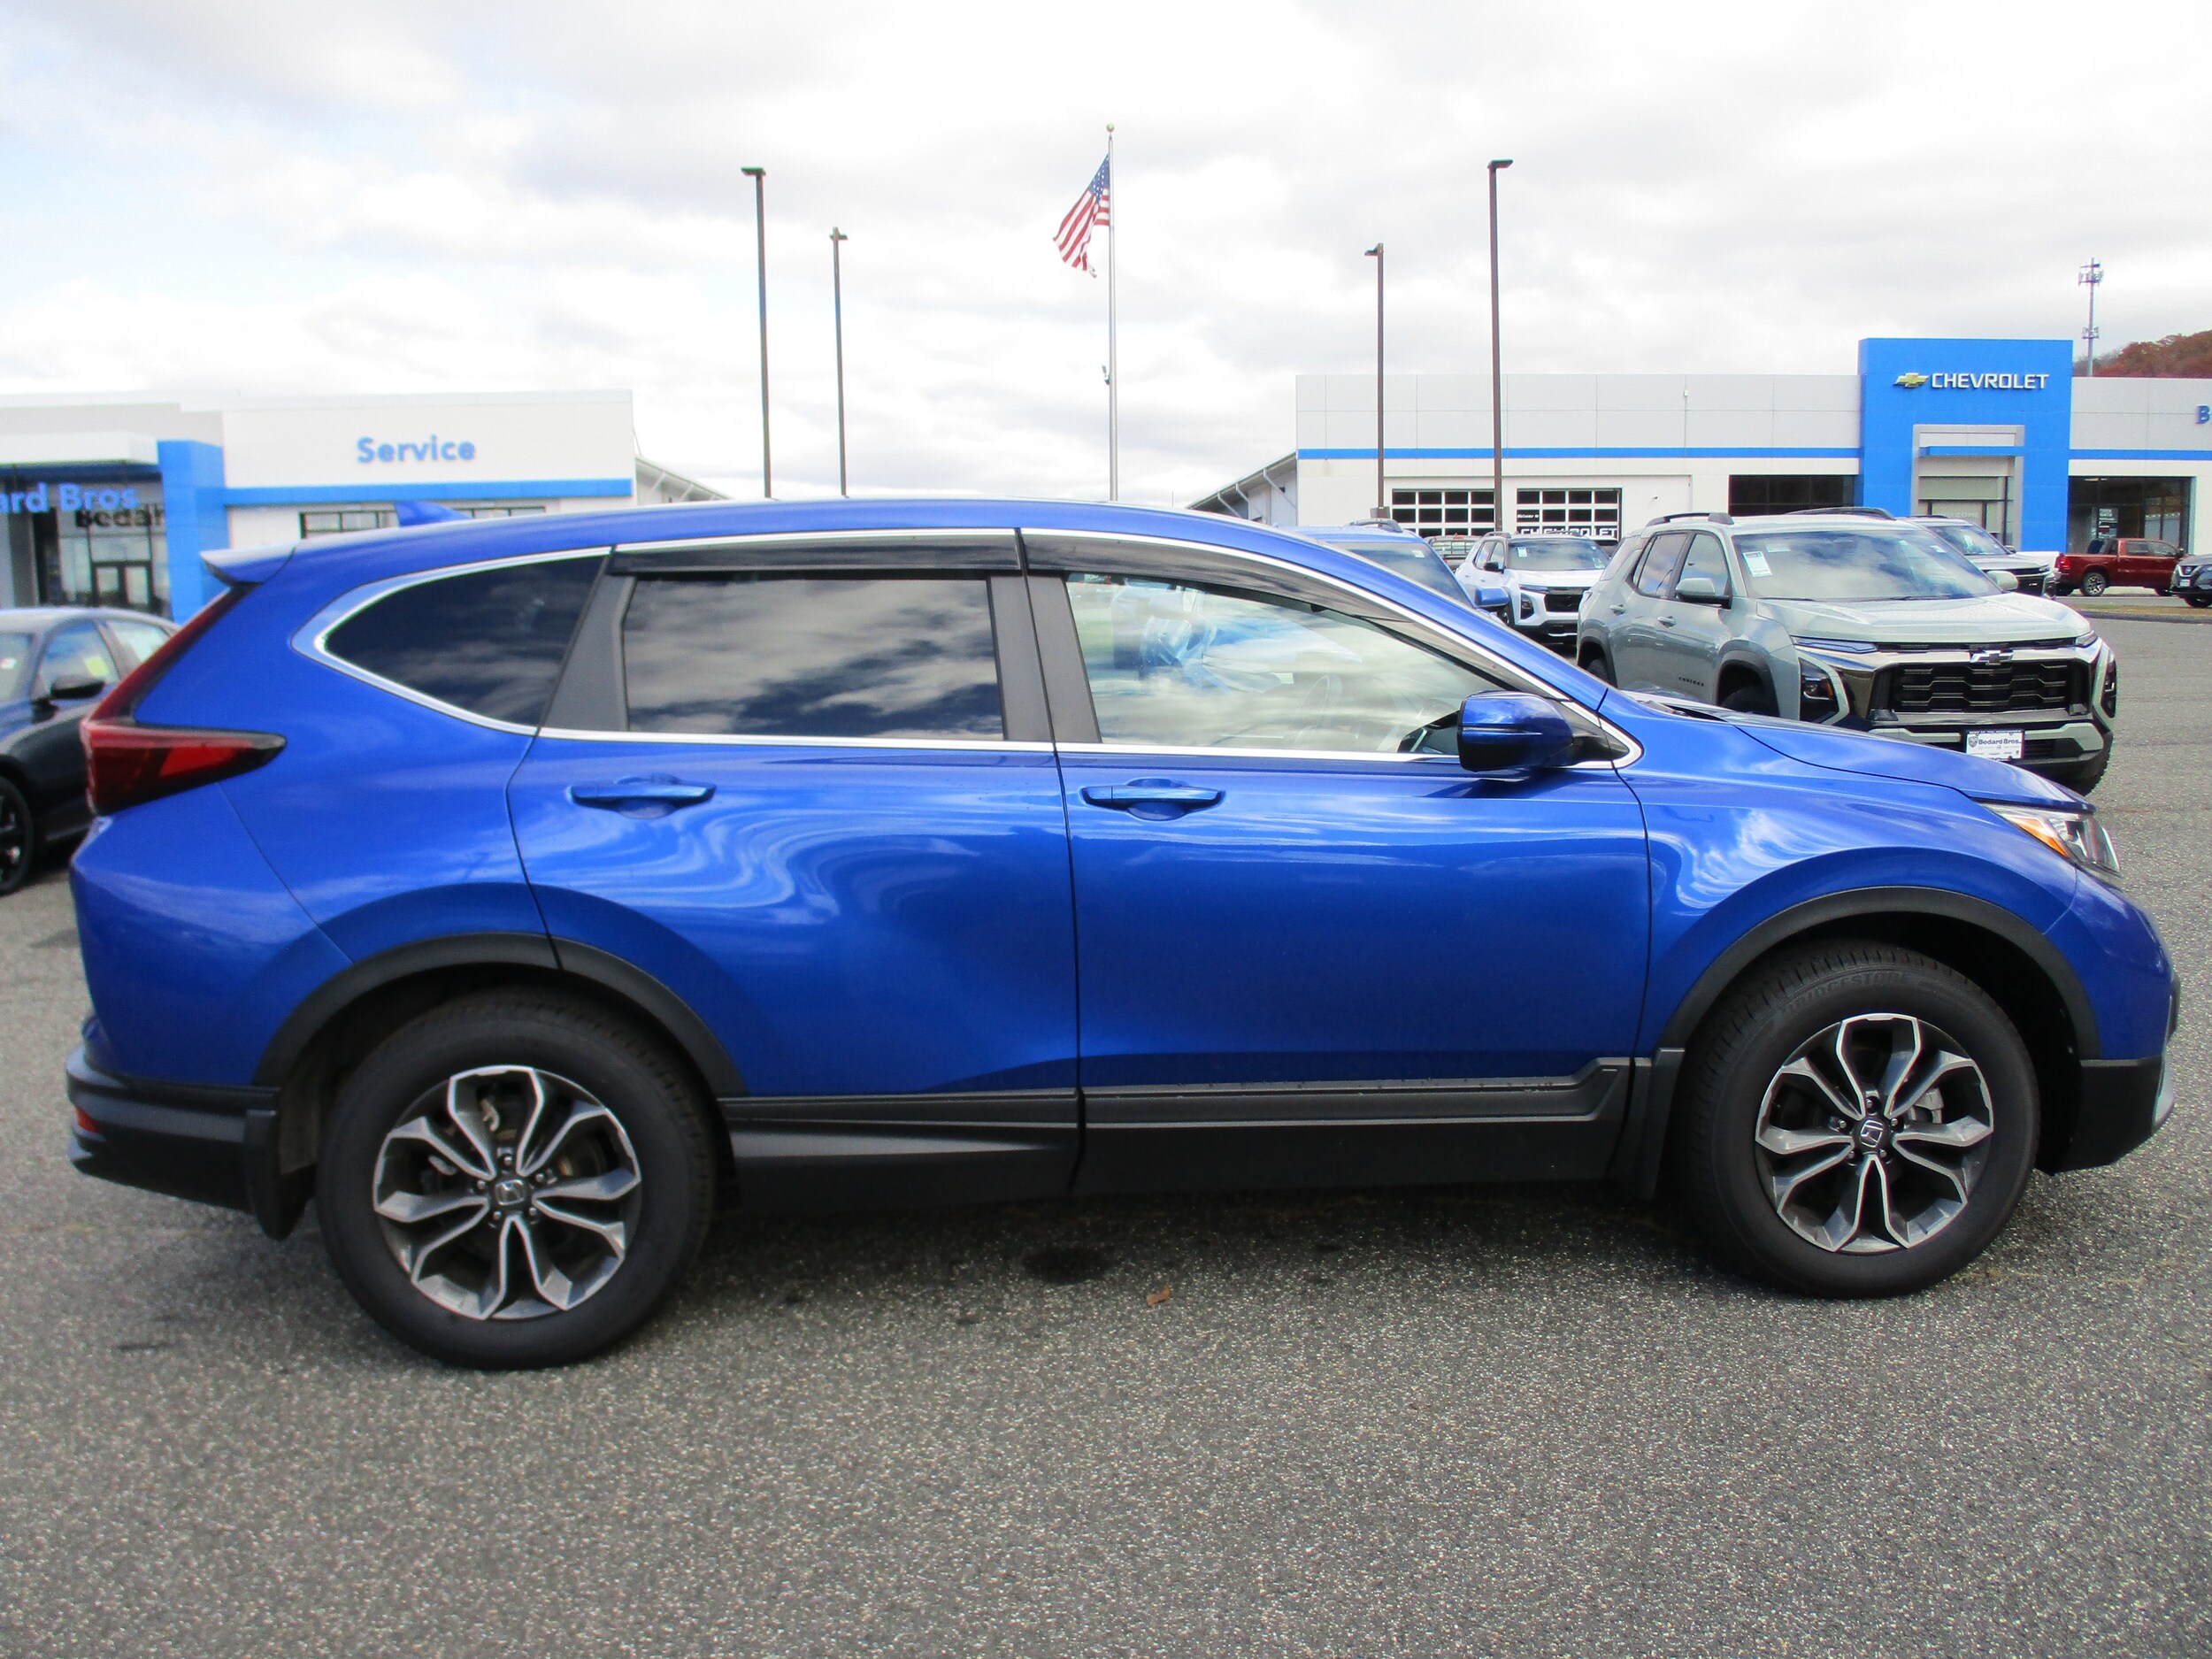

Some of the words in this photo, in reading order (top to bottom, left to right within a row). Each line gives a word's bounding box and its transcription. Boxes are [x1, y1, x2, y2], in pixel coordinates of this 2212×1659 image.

[1932, 373, 2049, 389] CHEVROLET
[357, 434, 476, 464] Service
[58, 482, 139, 511] Bros
[1520, 528, 1617, 537] CHOLET
